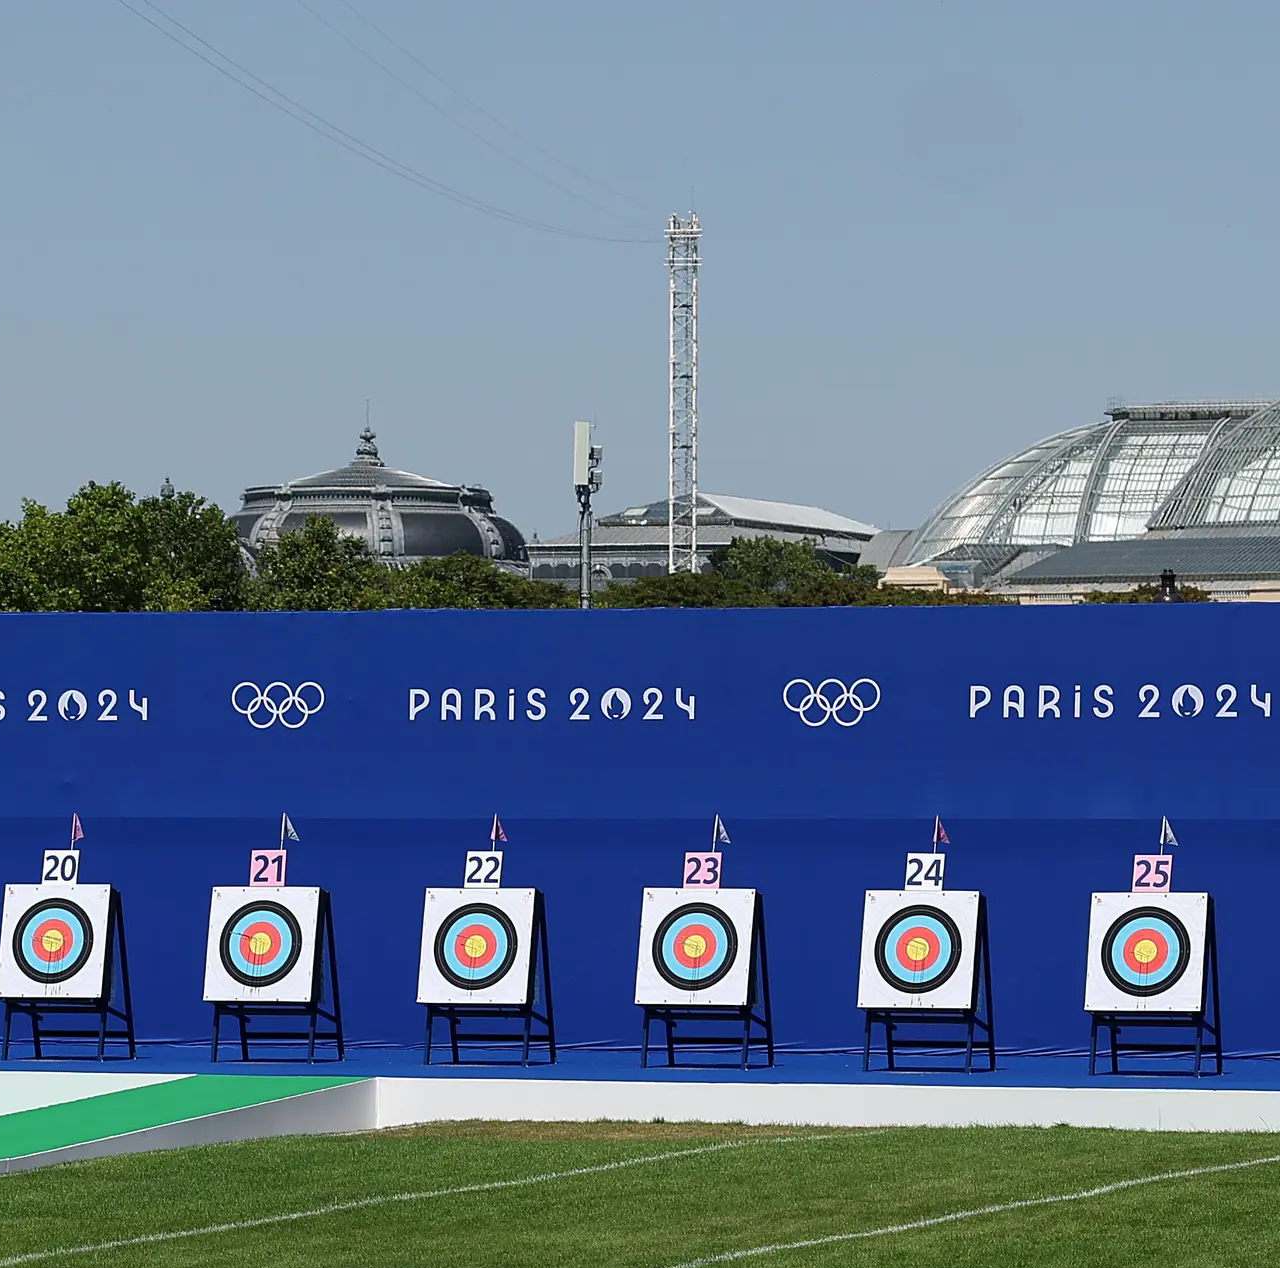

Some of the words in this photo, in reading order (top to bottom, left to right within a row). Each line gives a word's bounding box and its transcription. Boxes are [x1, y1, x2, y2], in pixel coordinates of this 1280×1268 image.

[28, 689, 147, 721] 2024
[570, 688, 695, 720] 2024
[1138, 684, 1270, 717] 2024
[43, 854, 77, 882] 20
[253, 854, 284, 883] 21
[466, 856, 500, 884] 22
[685, 856, 719, 885] 23
[906, 858, 943, 886] 24
[1134, 859, 1170, 888] 25
